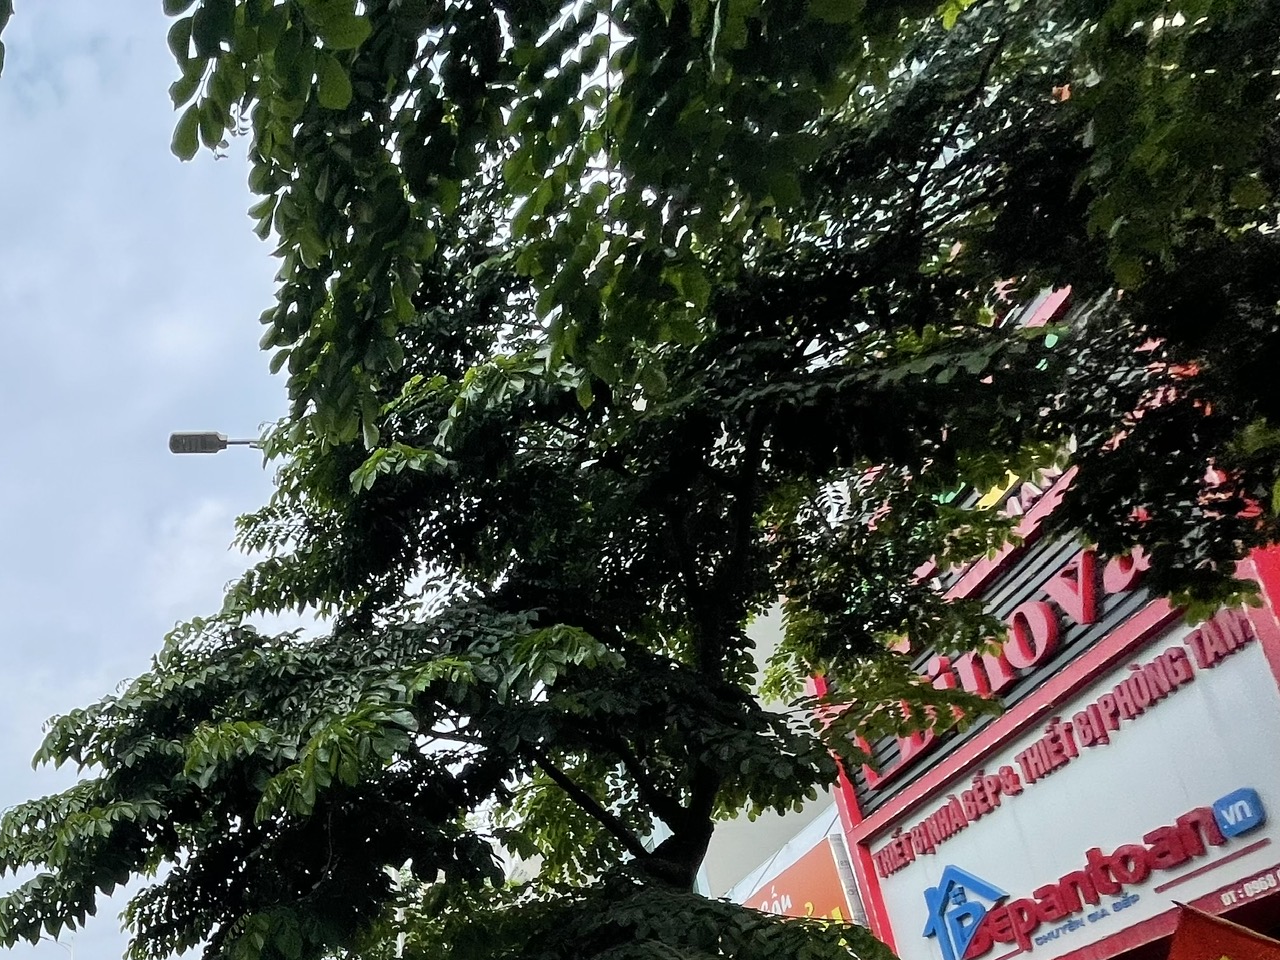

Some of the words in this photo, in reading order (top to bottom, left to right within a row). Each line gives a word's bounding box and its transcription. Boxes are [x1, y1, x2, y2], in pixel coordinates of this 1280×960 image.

[999, 766, 1024, 796] &
[1014, 716, 1080, 785] THIẾT
[1096, 645, 1195, 731] PHÒNG
